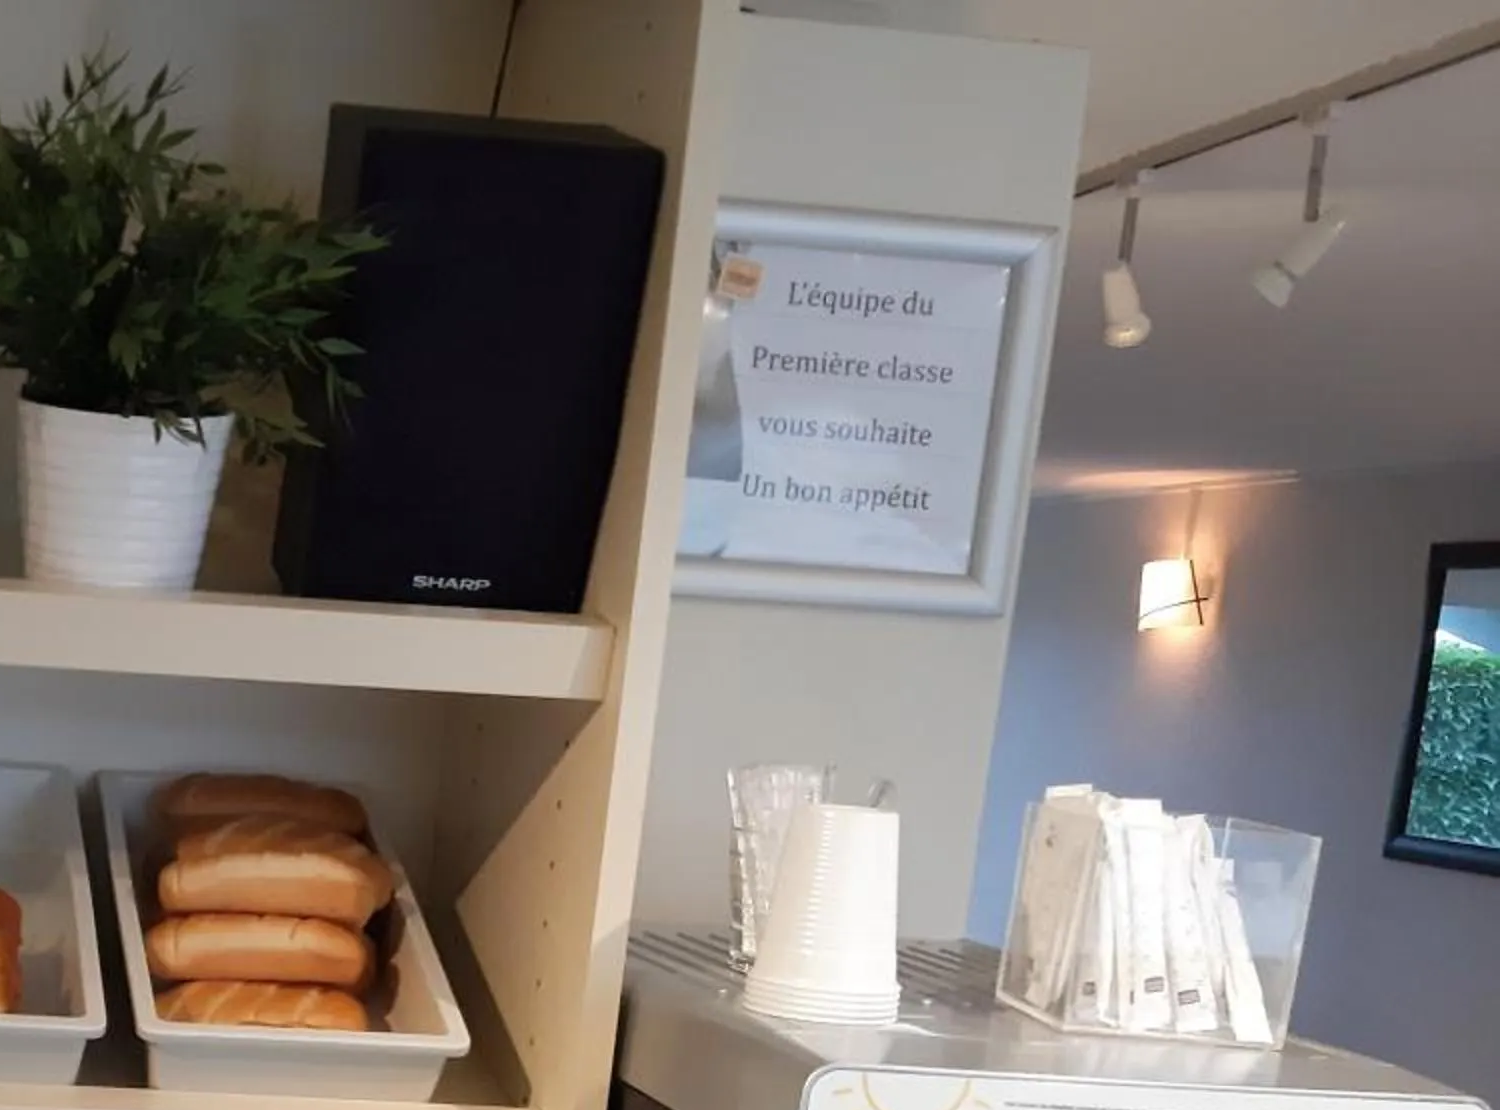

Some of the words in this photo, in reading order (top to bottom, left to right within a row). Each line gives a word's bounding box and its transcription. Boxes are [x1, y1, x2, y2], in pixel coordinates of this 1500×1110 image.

[787, 281, 896, 318] L'équipe
[901, 291, 934, 316] du
[751, 345, 870, 378] Première
[877, 356, 954, 384] classe
[759, 414, 818, 438] vous
[825, 418, 933, 447] souhaite
[741, 473, 776, 499] Un
[784, 477, 832, 503] bon
[840, 483, 932, 512] appétit
[412, 575, 492, 591] SHARP
